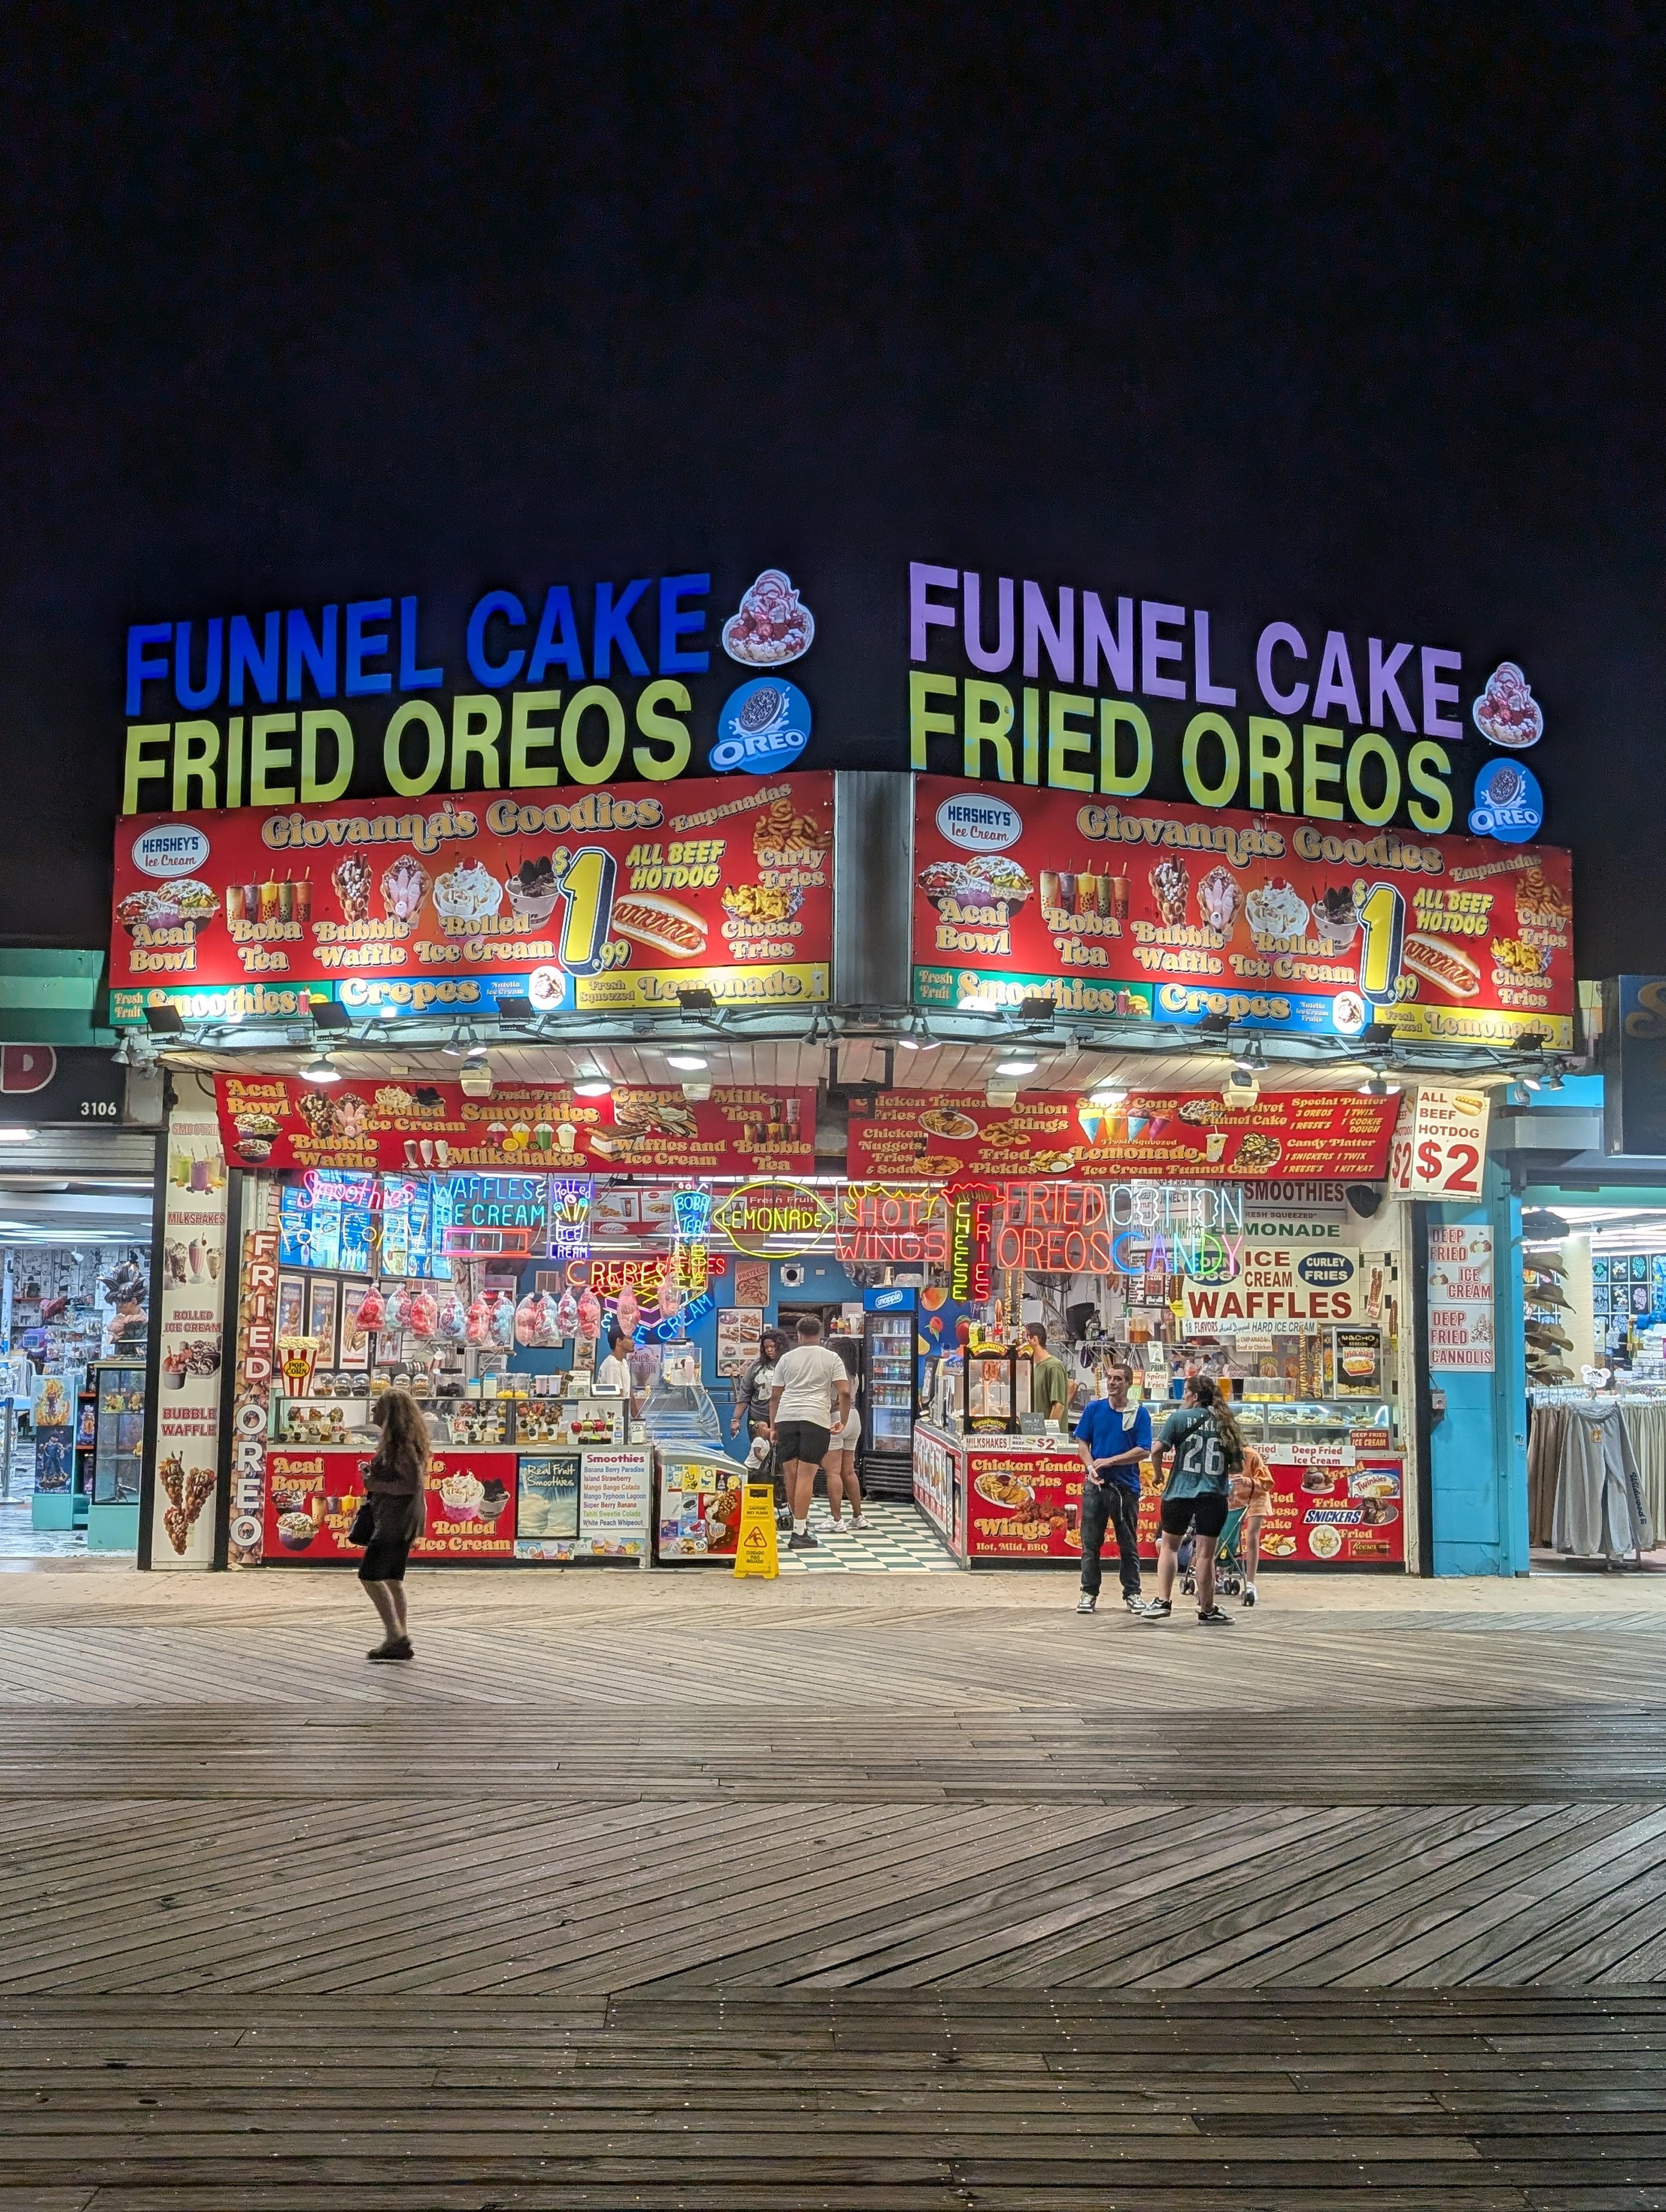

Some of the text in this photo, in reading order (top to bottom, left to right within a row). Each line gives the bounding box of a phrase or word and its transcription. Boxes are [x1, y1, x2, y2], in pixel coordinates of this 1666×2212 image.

[124, 573, 710, 716] FUNNEL CAKE
[909, 562, 1463, 739] FUNNEL CAKE
[123, 679, 692, 814] FRIED OREOS
[714, 731, 805, 768] OREO
[909, 670, 1453, 834] FRIED OREOS
[670, 783, 792, 833] Empanadas
[262, 793, 663, 854] Giovanna's Goodies
[1471, 808, 1539, 829] OREO
[142, 836, 200, 853] HERSHEY'S
[1077, 805, 1444, 876] Giovanna's Goodies
[145, 854, 196, 867] Ice Cream
[626, 840, 725, 868] ALL BEEF
[757, 848, 826, 869] Curly
[630, 865, 721, 890] HOTDOG
[759, 869, 826, 889] Fries
[228, 918, 303, 944] Boba
[312, 918, 411, 944] Bubble
[439, 912, 531, 938] Rolled
[722, 921, 804, 939] Cheese
[134, 922, 195, 947] Acai
[313, 944, 408, 968] Waffle
[415, 940, 555, 962] Ice Cream
[729, 939, 796, 959] Fries
[130, 948, 196, 973] Bowl
[238, 944, 290, 972] Tea
[638, 971, 802, 1000] Lemonade
[114, 992, 143, 1005] Fresh
[340, 977, 480, 1012] Crepes
[114, 1006, 142, 1019] Fruit
[711, 1088, 777, 1105] Milk
[1132, 1098, 1178, 1109] Cone
[1292, 1097, 1387, 1108] Special Platter
[1419, 1092, 1447, 1103] ALL
[81, 1102, 117, 1116] 3106
[462, 1103, 600, 1123] Smoothies
[1011, 1101, 1069, 1115] Onion
[1303, 1109, 1334, 1117] OREOS
[1419, 1108, 1456, 1120] BEEF
[1008, 1118, 1069, 1133] Rings
[1419, 1125, 1479, 1138] HOTDOG
[289, 1133, 380, 1152] Bubble
[612, 1139, 727, 1153] Waffles and
[733, 1139, 813, 1155] Bubble
[1287, 1139, 1327, 1149] Candy
[292, 1152, 379, 1168] Waffle
[447, 1147, 587, 1167] Milkshakes
[978, 1148, 1031, 1160] Fried
[1069, 1145, 1199, 1161] Lemonade
[1291, 1153, 1334, 1161] SNICKERS
[752, 1155, 792, 1172] Tea
[969, 1162, 1038, 1175] Pickles
[1081, 1164, 1268, 1175] Ice Cream Funnel Cake
[1416, 1140, 1479, 1192] $2
[433, 1177, 534, 1200] WAFFLES
[1244, 1181, 1344, 1201] SMOOTHIES
[675, 1196, 709, 1212] BOBA
[1004, 1182, 1104, 1225] FRIED
[1111, 1186, 1243, 1229] COTTON
[167, 1212, 226, 1226] MILKSHAKES
[440, 1204, 545, 1226] ICE CREAM
[721, 1209, 823, 1231] LEMONADE
[858, 1199, 921, 1227] HOT
[681, 1215, 706, 1234] TEA
[1211, 1223, 1340, 1237] LEMONADE
[559, 1227, 582, 1241] ICE
[1431, 1228, 1465, 1244] DEEP
[550, 1244, 588, 1259] CREAM
[837, 1231, 946, 1260] WINGS
[953, 1201, 970, 1302] CHEESE
[975, 1203, 991, 1301] FRIES
[998, 1228, 1110, 1272] OREOS
[1112, 1231, 1243, 1275] CANDY
[1430, 1246, 1468, 1262] FRIED
[1245, 1251, 1290, 1266] ICE
[1306, 1257, 1345, 1268] CURLEY
[1245, 1271, 1292, 1288] CREAM
[1305, 1270, 1348, 1281] FRIES
[1459, 1267, 1480, 1283] ICE
[877, 1292, 901, 1307] snapple
[1447, 1283, 1491, 1299] CREAM
[246, 1235, 275, 1379] FRIED
[1188, 1291, 1353, 1319] WAFFLES
[174, 1310, 213, 1321] ROLLED
[1432, 1310, 1466, 1327] DEEP
[165, 1323, 221, 1333] ICE CREAM
[1186, 1321, 1286, 1333] 18 FLAVORS HARD ICE
[1430, 1329, 1469, 1346] FRIED
[1430, 1349, 1492, 1365] CANNOLIS
[162, 1407, 217, 1420] BUBBLE
[162, 1424, 216, 1437] WAFFLE
[966, 1438, 1007, 1448] MILKSHAKES
[1037, 1438, 1055, 1450] $2
[1291, 1446, 1342, 1456] Deep Fried
[587, 1454, 644, 1463] Smoothies
[1182, 1433, 1225, 1475] 26
[527, 1462, 550, 1475] Real
[971, 1459, 1034, 1472] Chicken
[231, 1403, 267, 1547] OREO
[527, 1475, 574, 1487] Smoothies
[1355, 1475, 1387, 1492] Twinkies
[1312, 1497, 1348, 1508] Fried
[1305, 1510, 1361, 1523] SNICKERS
[974, 1518, 1052, 1541] Wings
[976, 1542, 1049, 1553] Hot, Mild, BBQ
